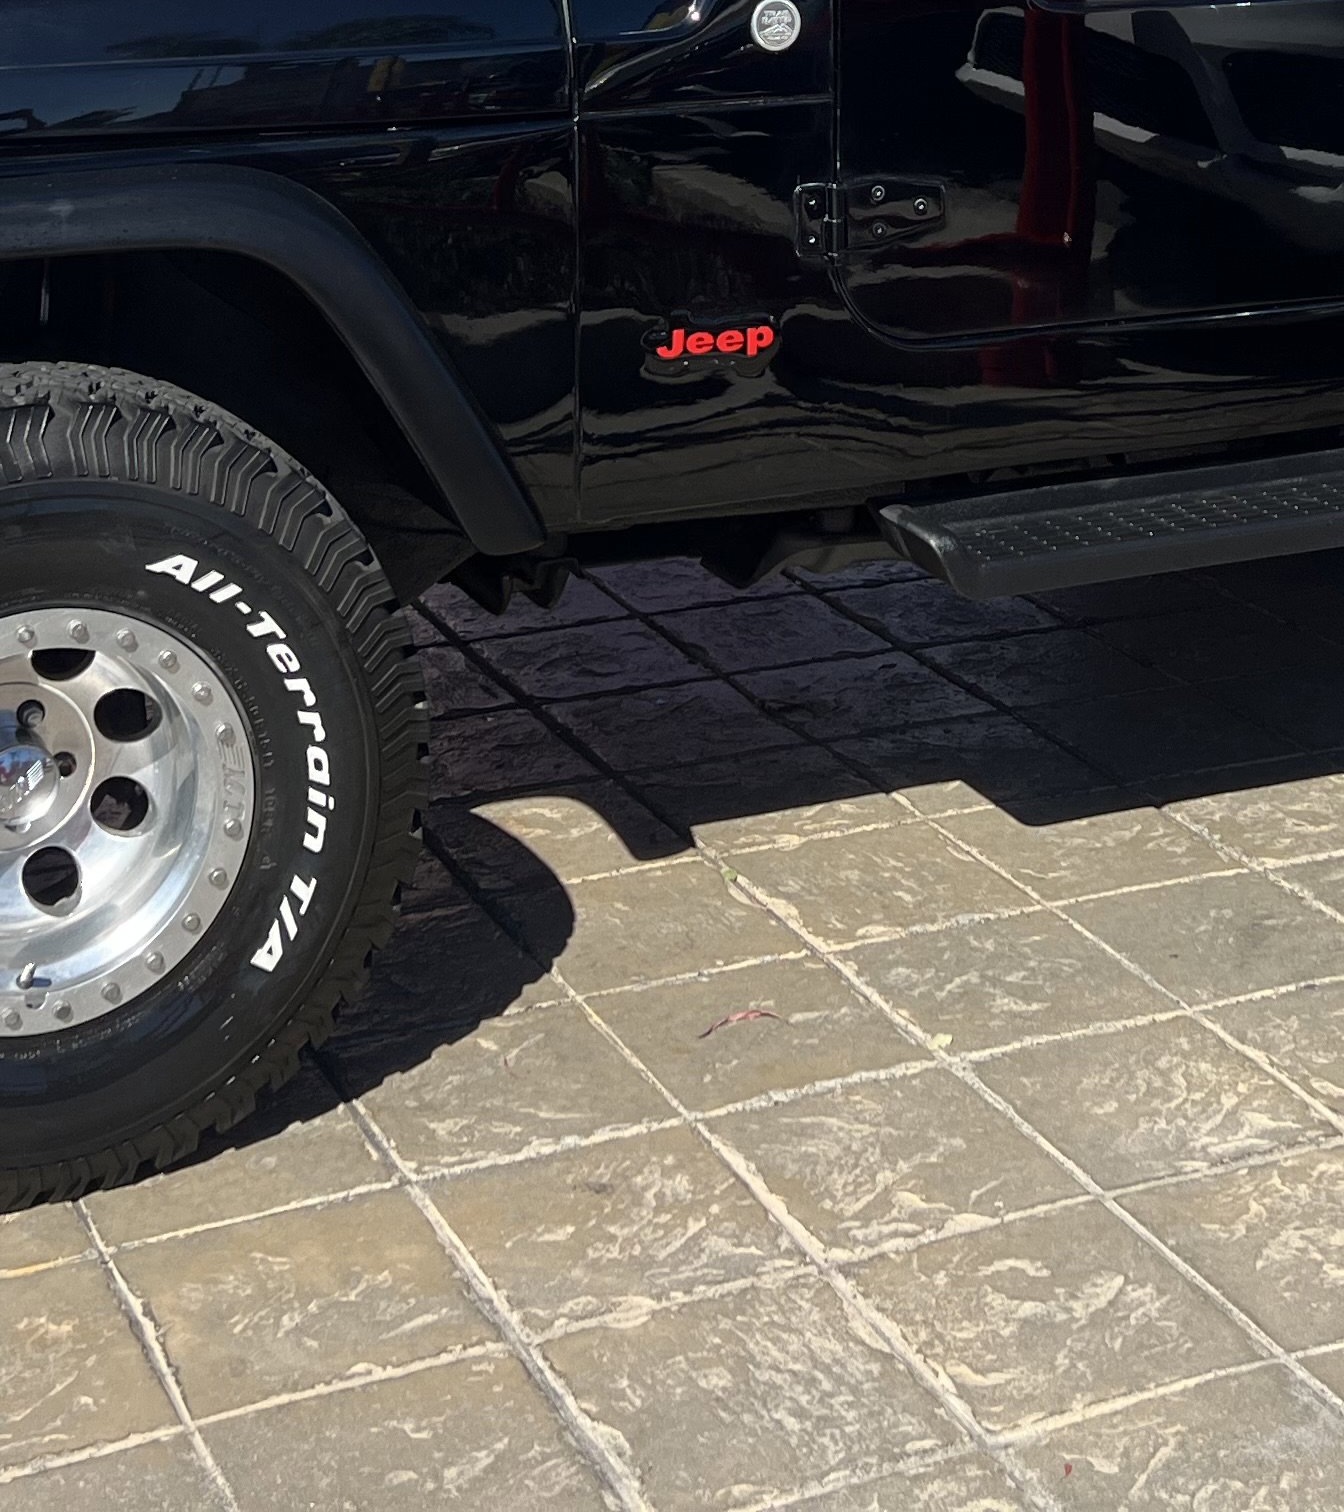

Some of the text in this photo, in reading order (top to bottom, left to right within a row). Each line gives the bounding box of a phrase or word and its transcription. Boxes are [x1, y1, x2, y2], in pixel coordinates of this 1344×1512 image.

[656, 325, 774, 360] Jeep
[144, 553, 335, 973] All-Terrain T/A
